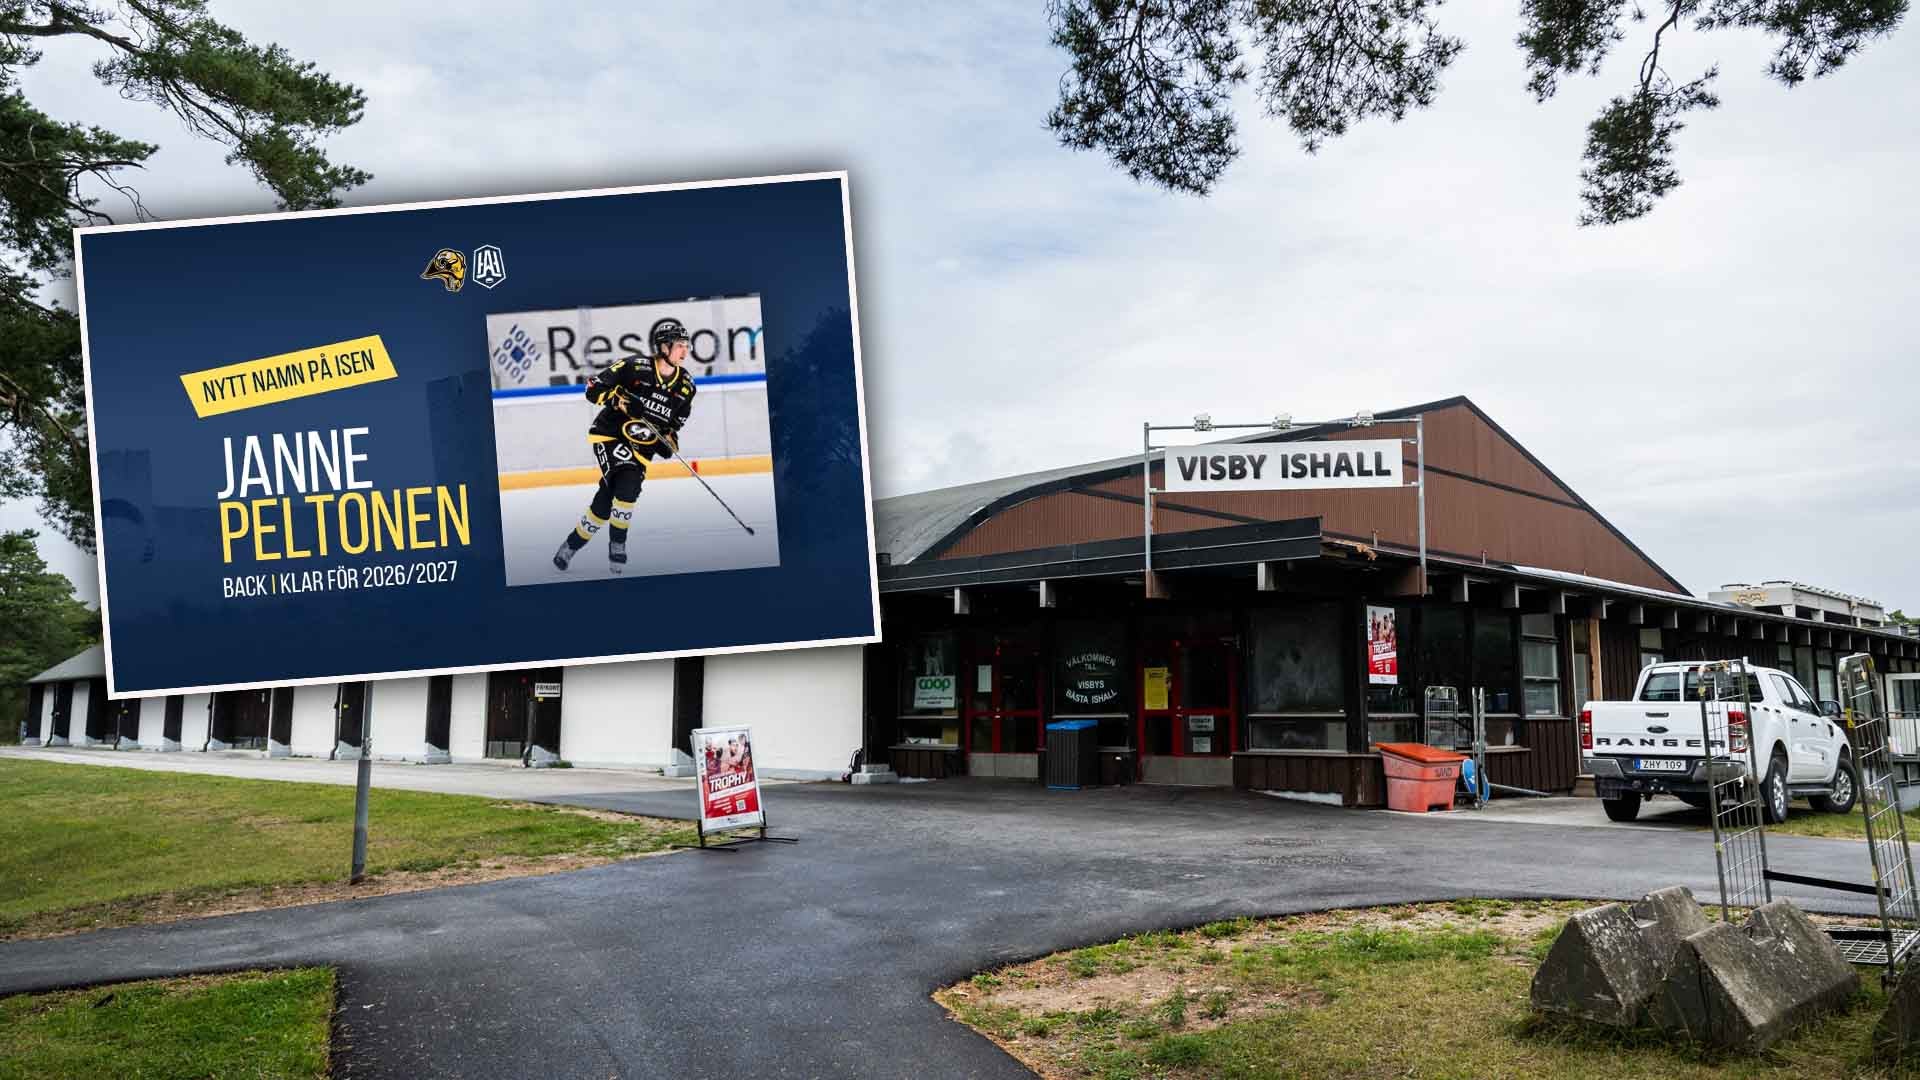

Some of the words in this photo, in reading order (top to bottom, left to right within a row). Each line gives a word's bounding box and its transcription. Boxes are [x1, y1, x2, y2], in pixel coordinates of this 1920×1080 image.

[1177, 454, 1267, 481] VISBY
[1281, 451, 1392, 479] ISHALL
[1077, 680, 1105, 689] VISBYS
[1091, 689, 1118, 704] ISHALL
[1596, 738, 1725, 748] RANGER
[1643, 761, 1661, 769] ZHY
[1665, 761, 1682, 769] 109
[709, 772, 748, 793] TROPHY
